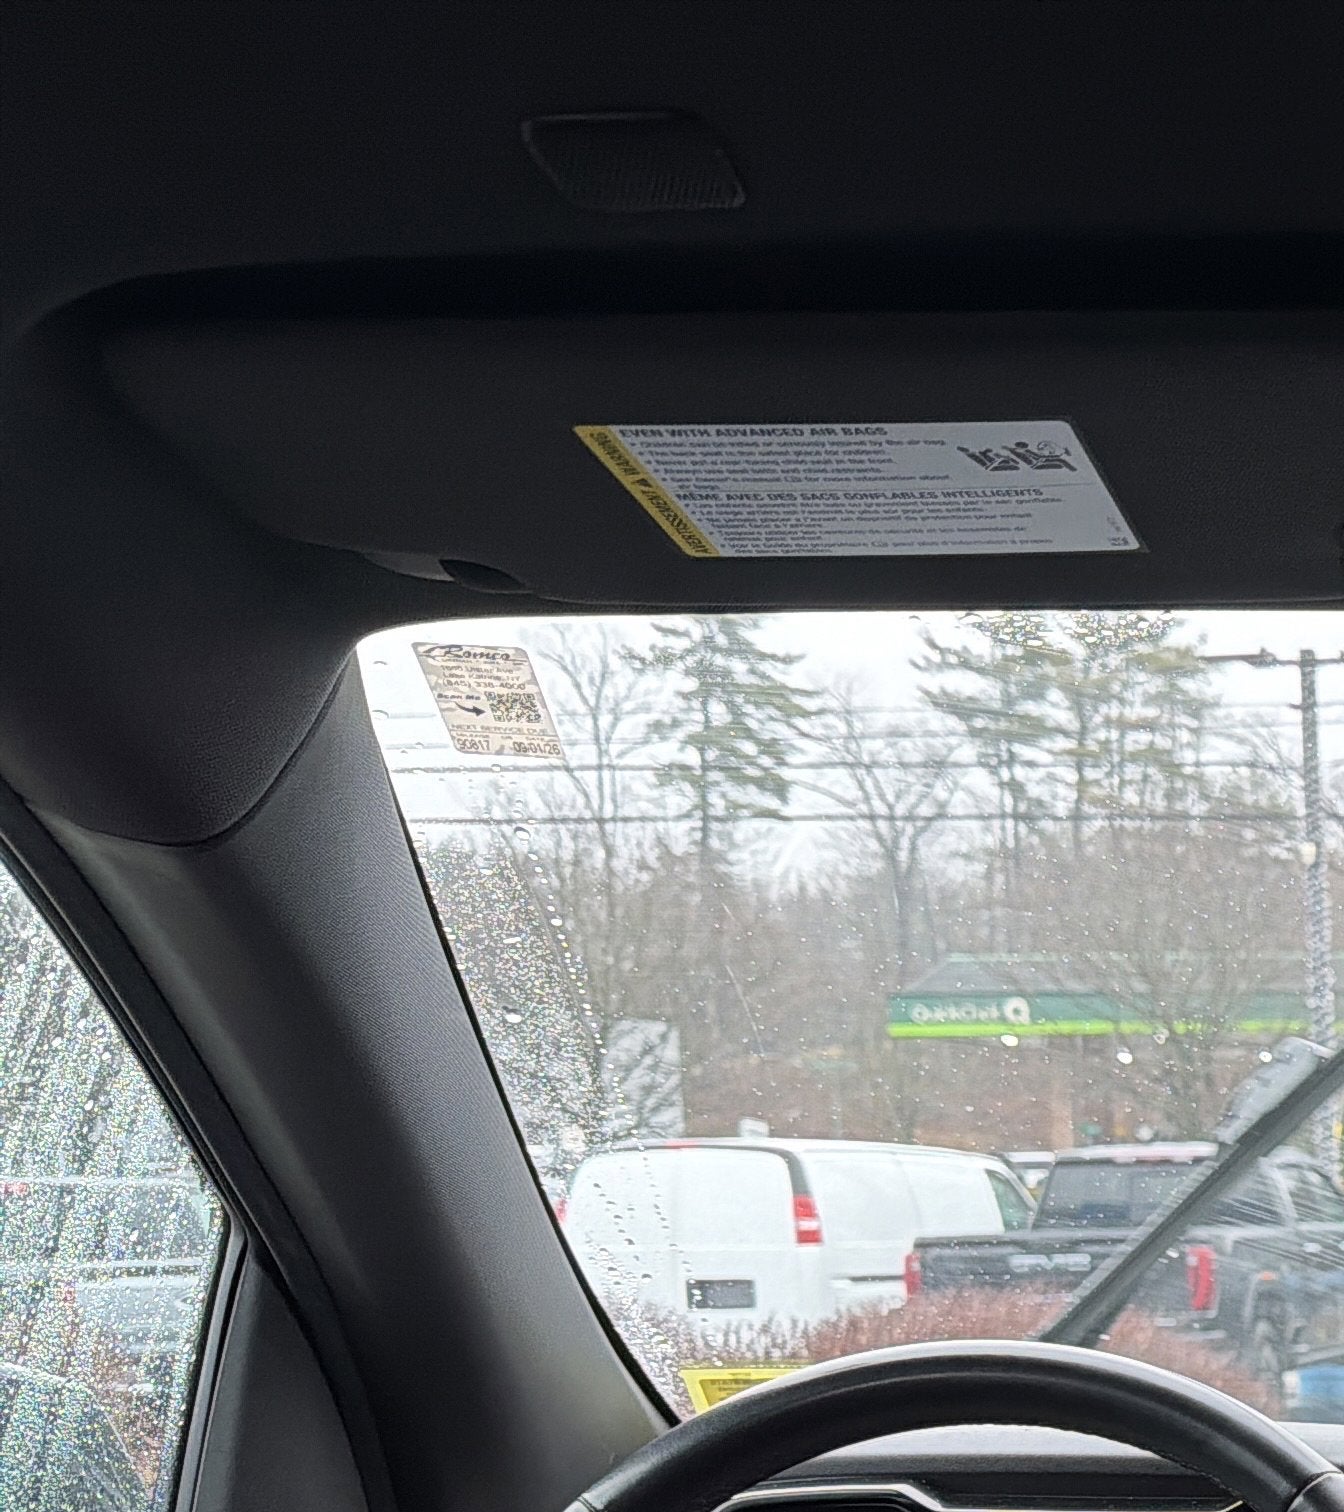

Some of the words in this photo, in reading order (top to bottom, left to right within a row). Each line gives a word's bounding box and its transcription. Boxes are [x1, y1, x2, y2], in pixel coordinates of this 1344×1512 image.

[618, 428, 664, 438] EVEN
[665, 428, 712, 437] WITH
[715, 427, 805, 437] ADVANCED
[810, 426, 837, 437] AIR
[841, 426, 888, 436] BAGS
[800, 491, 841, 501] SACS
[843, 490, 939, 501] GONFLABLES
[940, 488, 1044, 499] INTELLIGENTS
